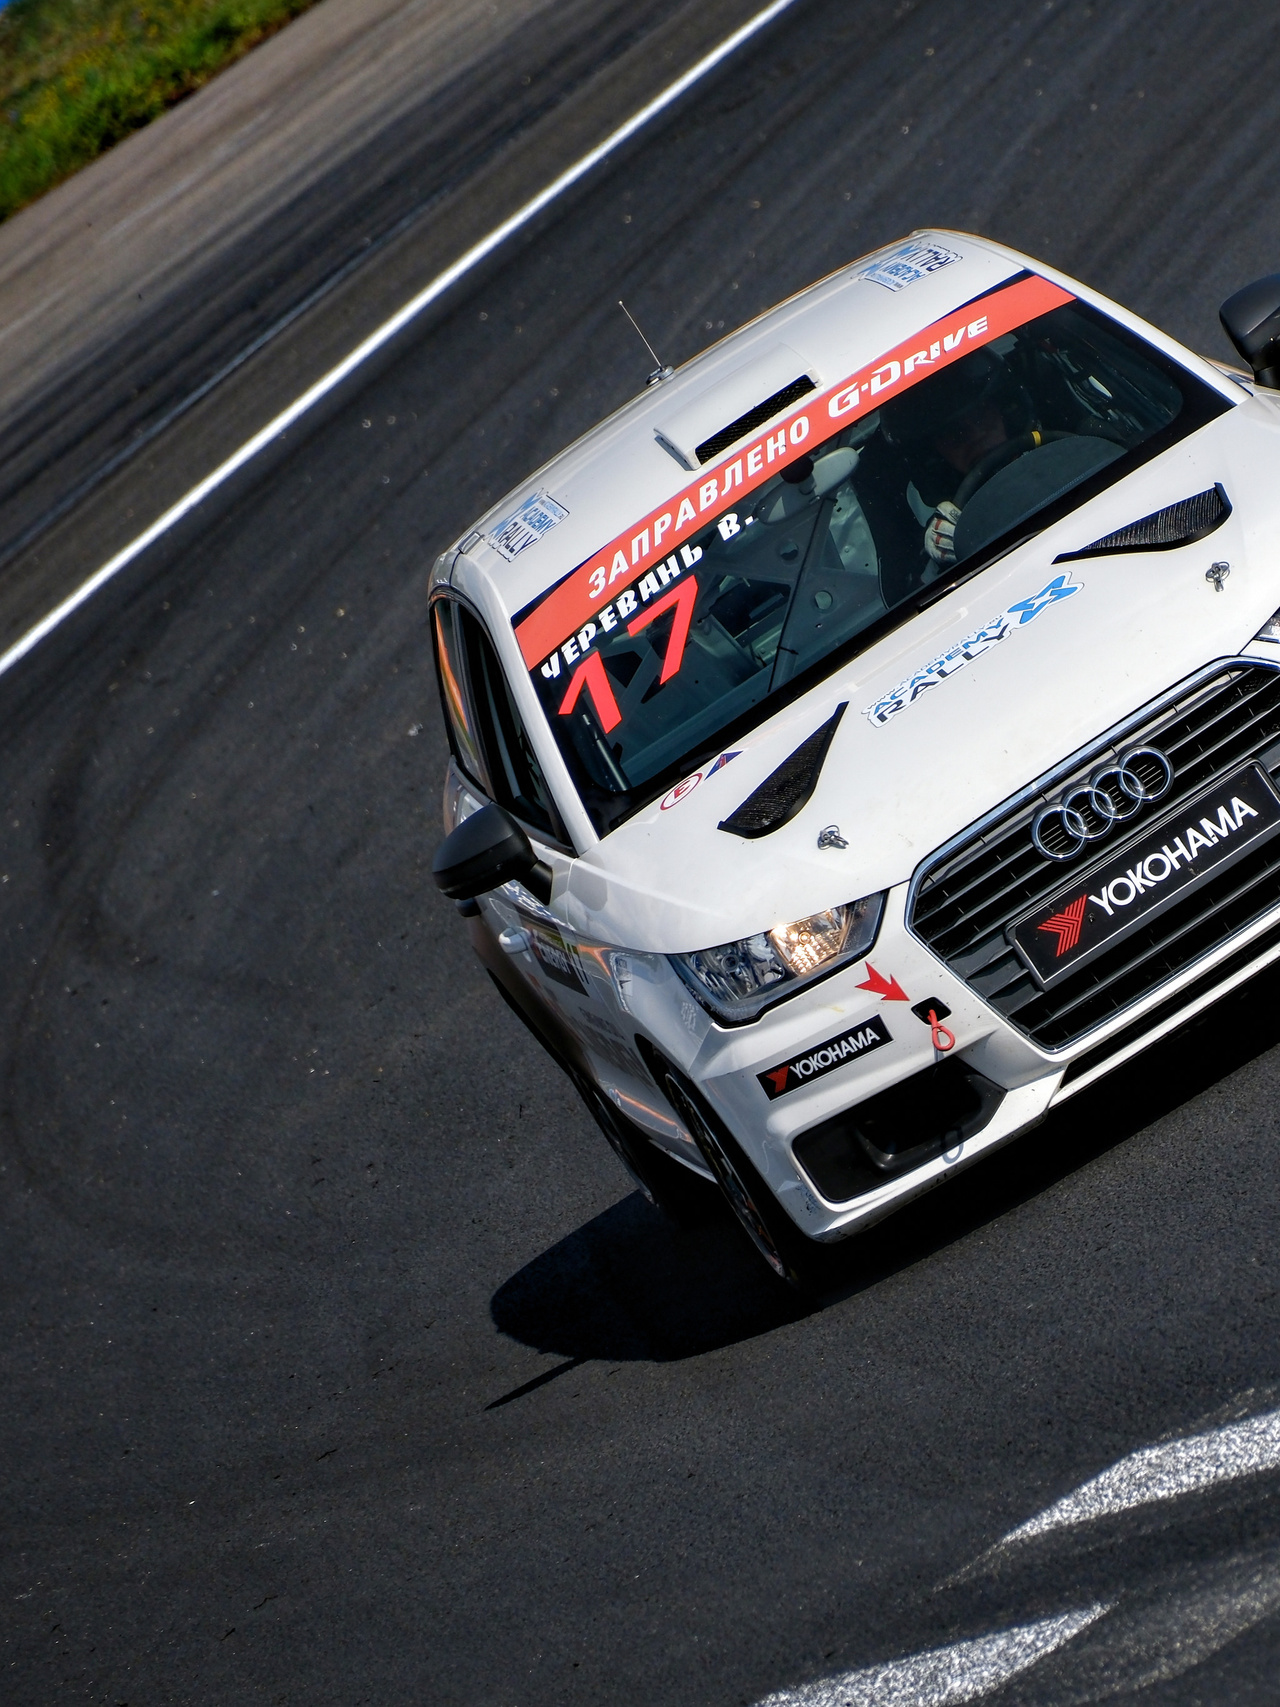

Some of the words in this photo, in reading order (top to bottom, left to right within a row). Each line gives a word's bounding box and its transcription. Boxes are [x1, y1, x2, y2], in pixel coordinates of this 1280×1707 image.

[901, 248, 956, 272] RALLY
[494, 521, 538, 557] RALLY
[519, 505, 557, 535] ACADEMY
[588, 416, 810, 599] ЗАПРАВЛЕНО
[540, 543, 704, 680] ЧЕРЕВАНЬ
[716, 511, 755, 542] В.
[558, 574, 698, 734] 17
[874, 617, 1005, 716] ACADEMY
[877, 622, 1010, 723] RALLY
[1088, 796, 1260, 917] YOKOHAMA
[789, 1026, 881, 1080] YOKOHAMA
